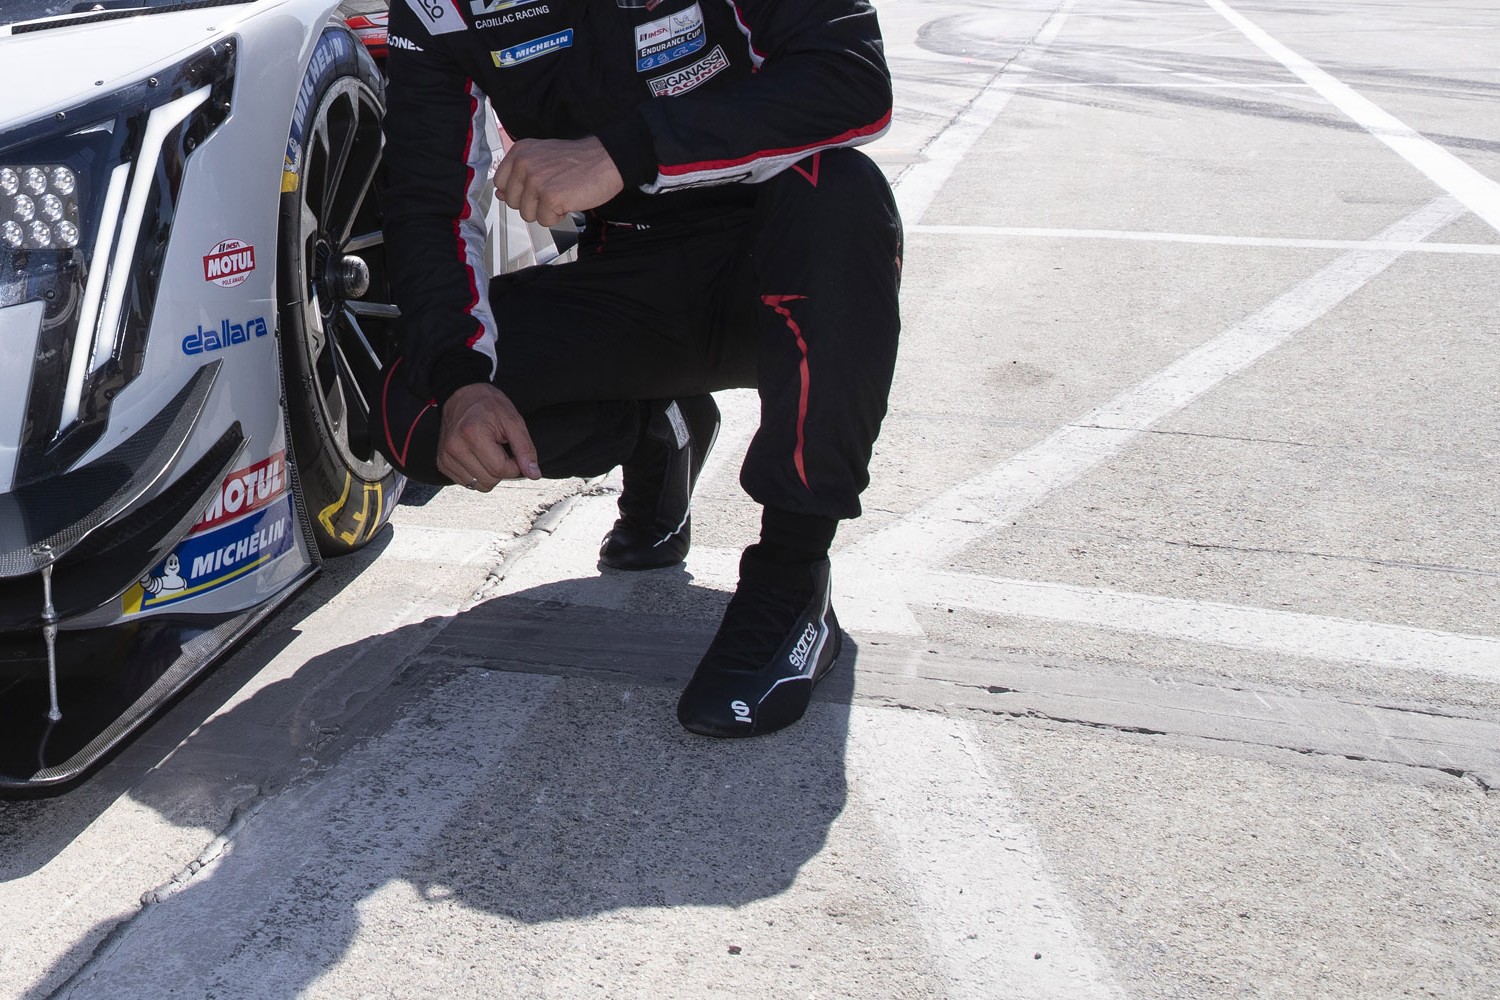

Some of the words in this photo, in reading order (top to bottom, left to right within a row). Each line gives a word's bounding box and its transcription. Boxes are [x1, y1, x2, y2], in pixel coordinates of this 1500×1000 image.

[475, 13, 515, 30] CADILLAC
[515, 5, 550, 21] RACING
[648, 27, 669, 39] IMSA
[515, 34, 569, 59] MICHELIN
[641, 35, 686, 58] ENDURANCE
[293, 36, 345, 131] MICHELIN
[665, 52, 722, 88] GANASSI
[207, 250, 254, 279] MOTUL
[221, 278, 232, 286] POLE
[232, 276, 245, 285] AWARD
[181, 316, 268, 356] dallara
[201, 458, 285, 523] MOTUL
[190, 517, 285, 579] MICHELIN
[788, 622, 818, 671] sparco
